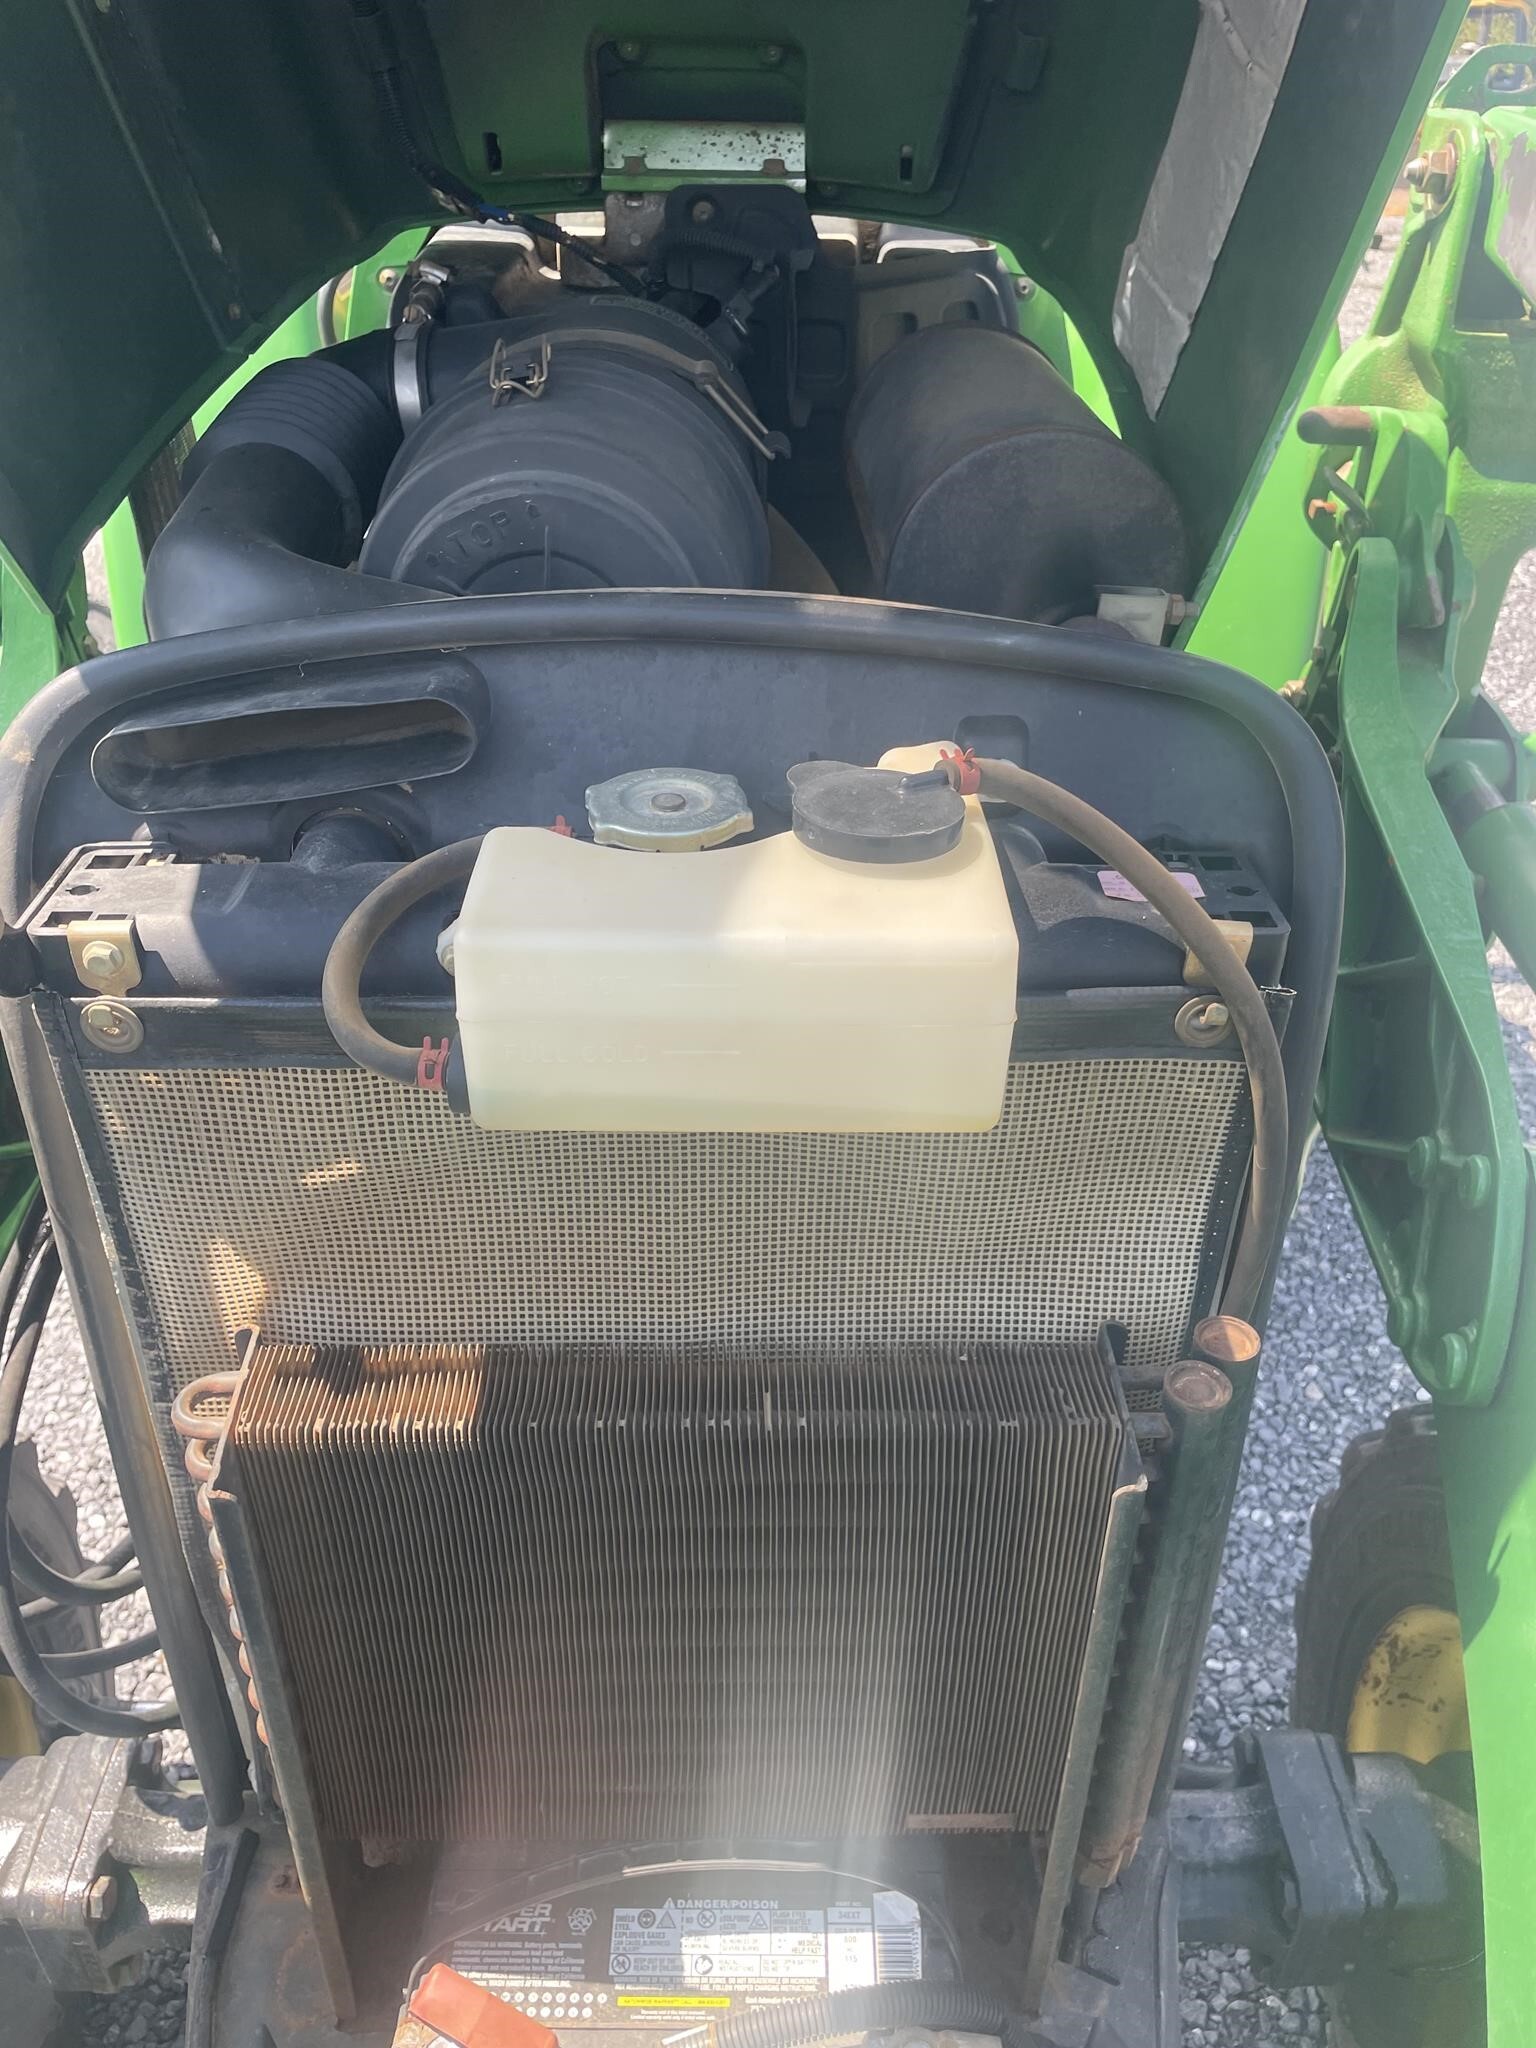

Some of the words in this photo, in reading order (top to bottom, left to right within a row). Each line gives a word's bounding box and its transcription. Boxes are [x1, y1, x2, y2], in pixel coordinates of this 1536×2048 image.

[446, 510, 512, 555] TOP
[503, 1040, 569, 1065] FULL
[579, 1040, 649, 1065] COLD
